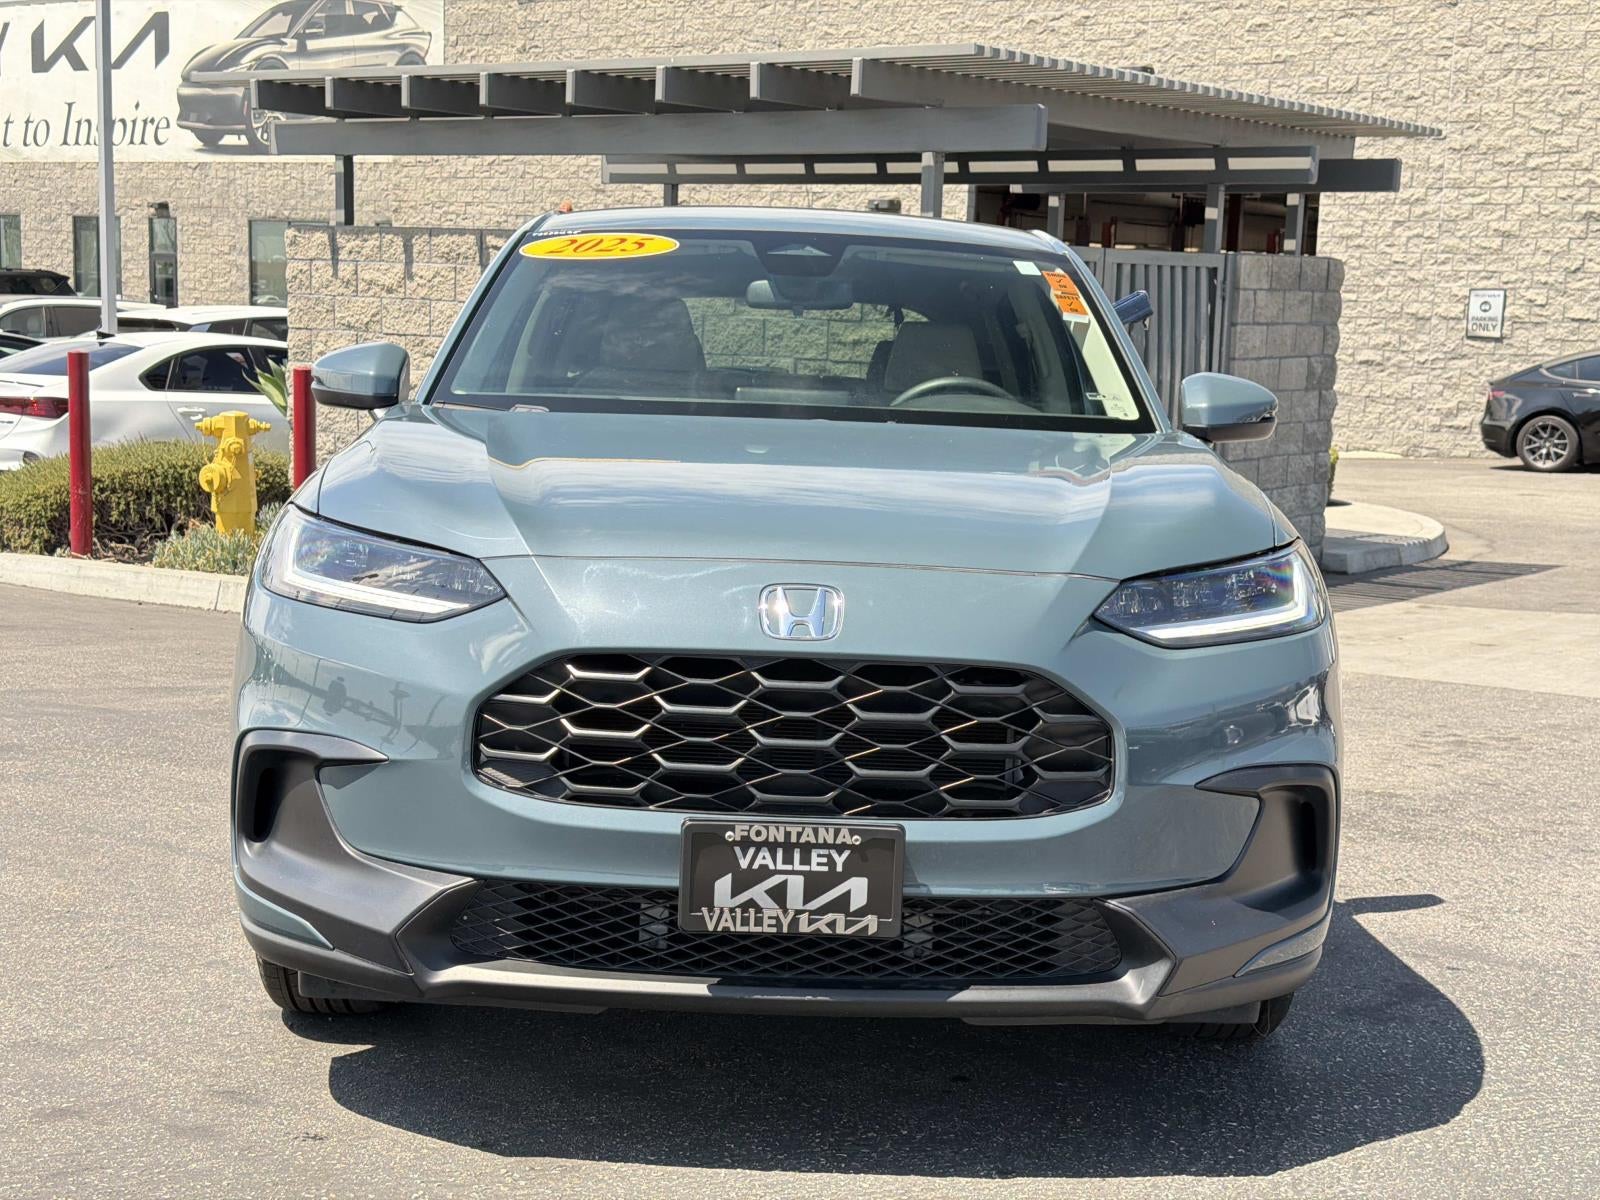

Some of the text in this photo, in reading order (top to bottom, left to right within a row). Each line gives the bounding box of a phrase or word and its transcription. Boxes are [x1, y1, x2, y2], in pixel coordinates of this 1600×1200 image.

[31, 11, 170, 74] KA
[22, 113, 51, 148] to
[59, 100, 171, 148] Inpire
[545, 237, 656, 254] 2025
[1471, 322, 1498, 332] ONLY
[734, 824, 853, 845] FONTANA
[733, 846, 851, 873] VALLEY
[714, 872, 869, 913] KIA
[701, 906, 878, 936] VALLEY KIA
